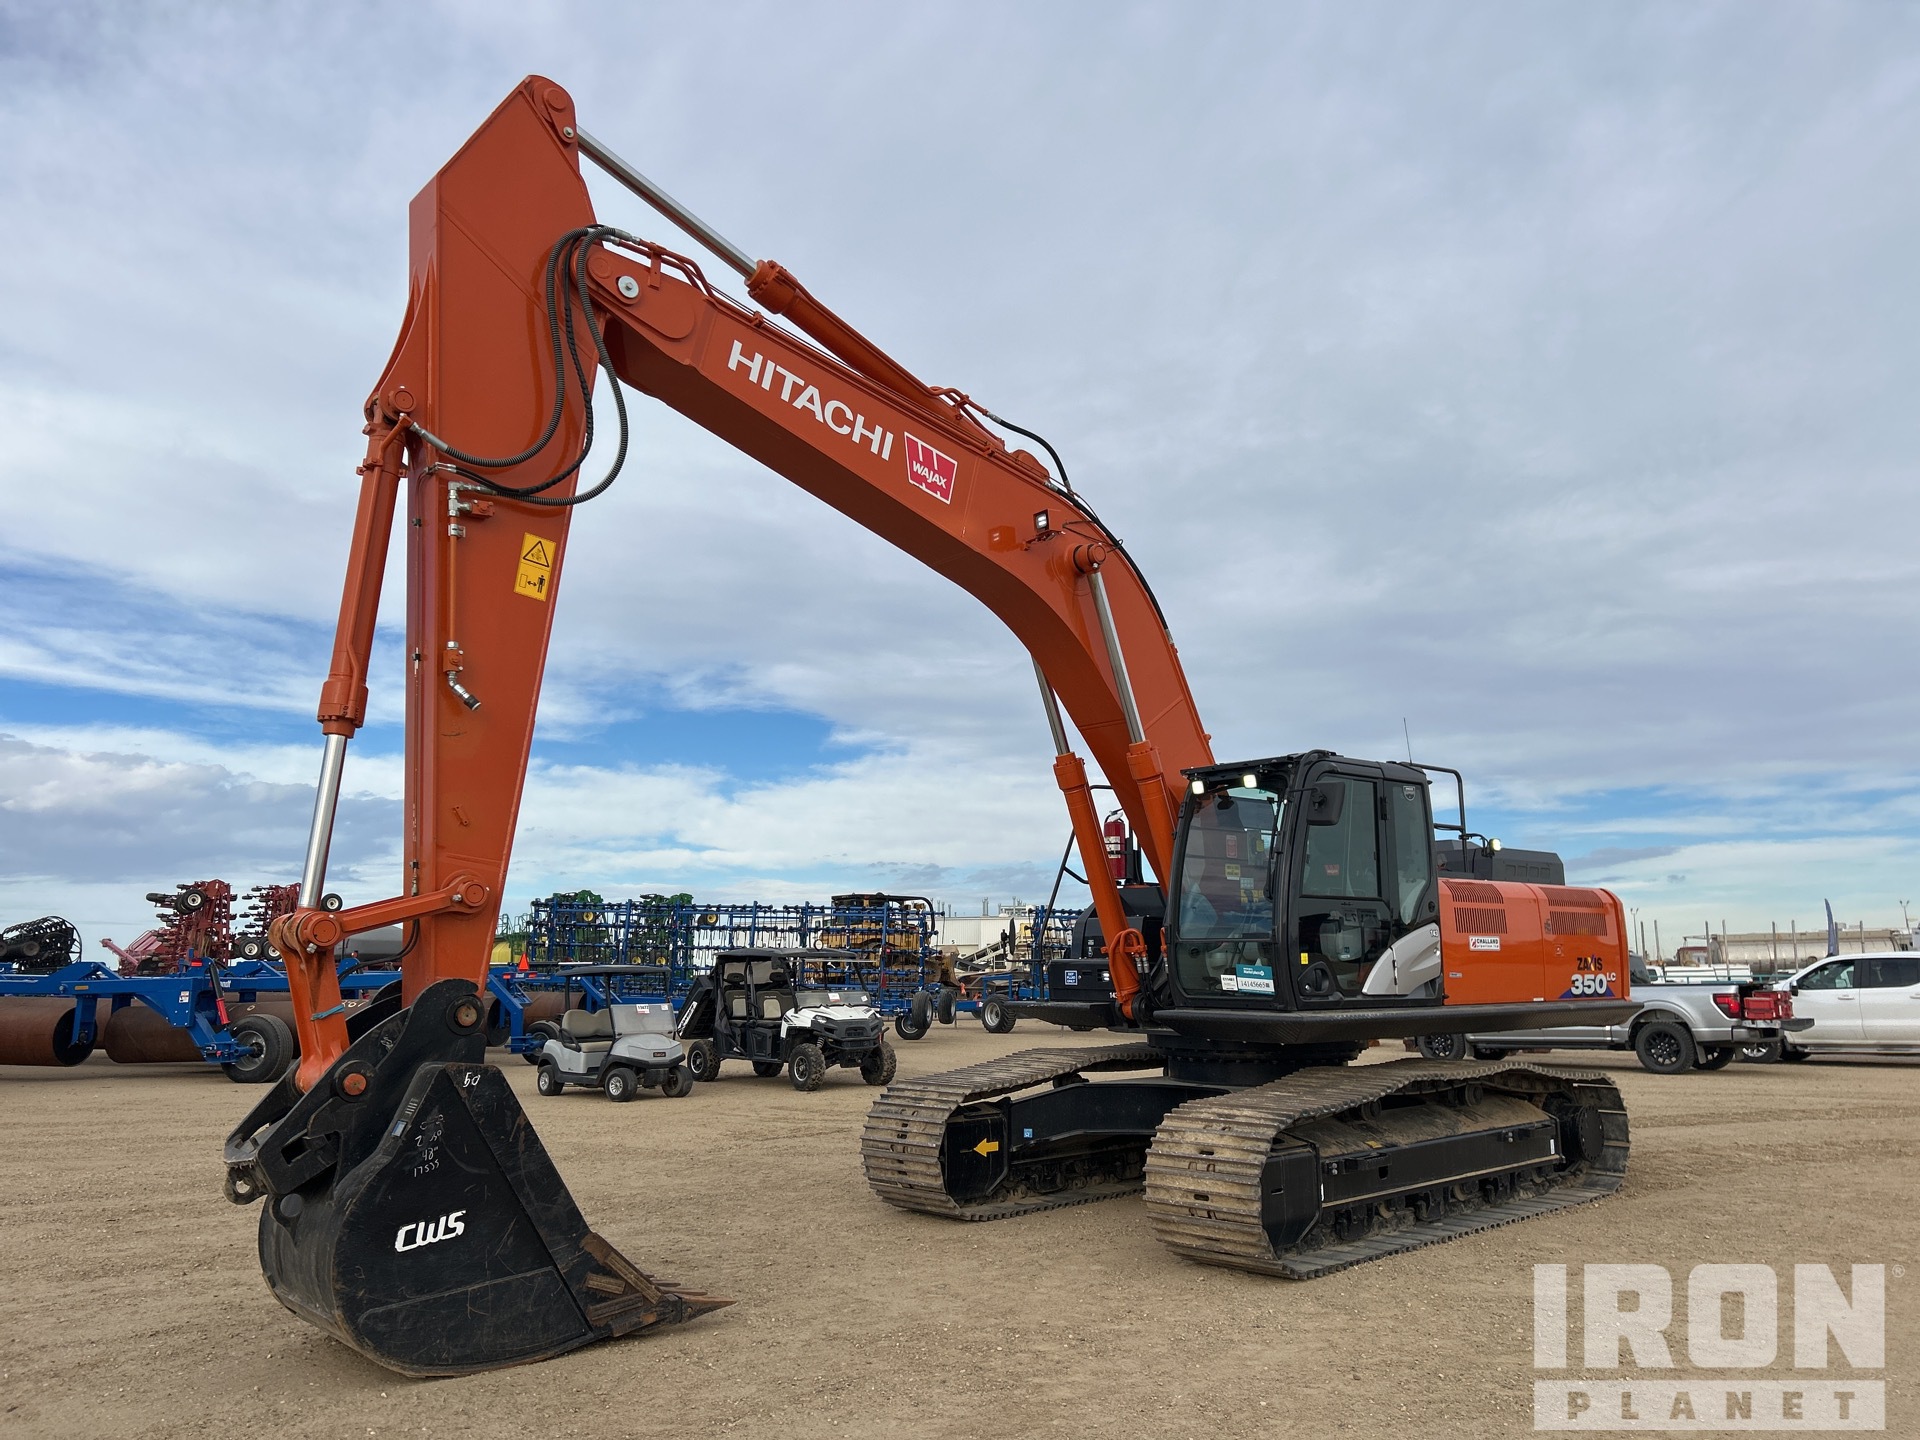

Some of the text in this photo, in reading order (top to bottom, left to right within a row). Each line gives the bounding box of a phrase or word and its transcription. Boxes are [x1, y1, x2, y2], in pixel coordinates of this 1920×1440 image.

[728, 340, 894, 461] HITACHI
[913, 460, 947, 489] WAJAX
[1577, 955, 1603, 971] ZAXIS
[1240, 980, 1265, 988] 14145665
[1570, 972, 1616, 995] 350 LC
[395, 1210, 466, 1252] CWS
